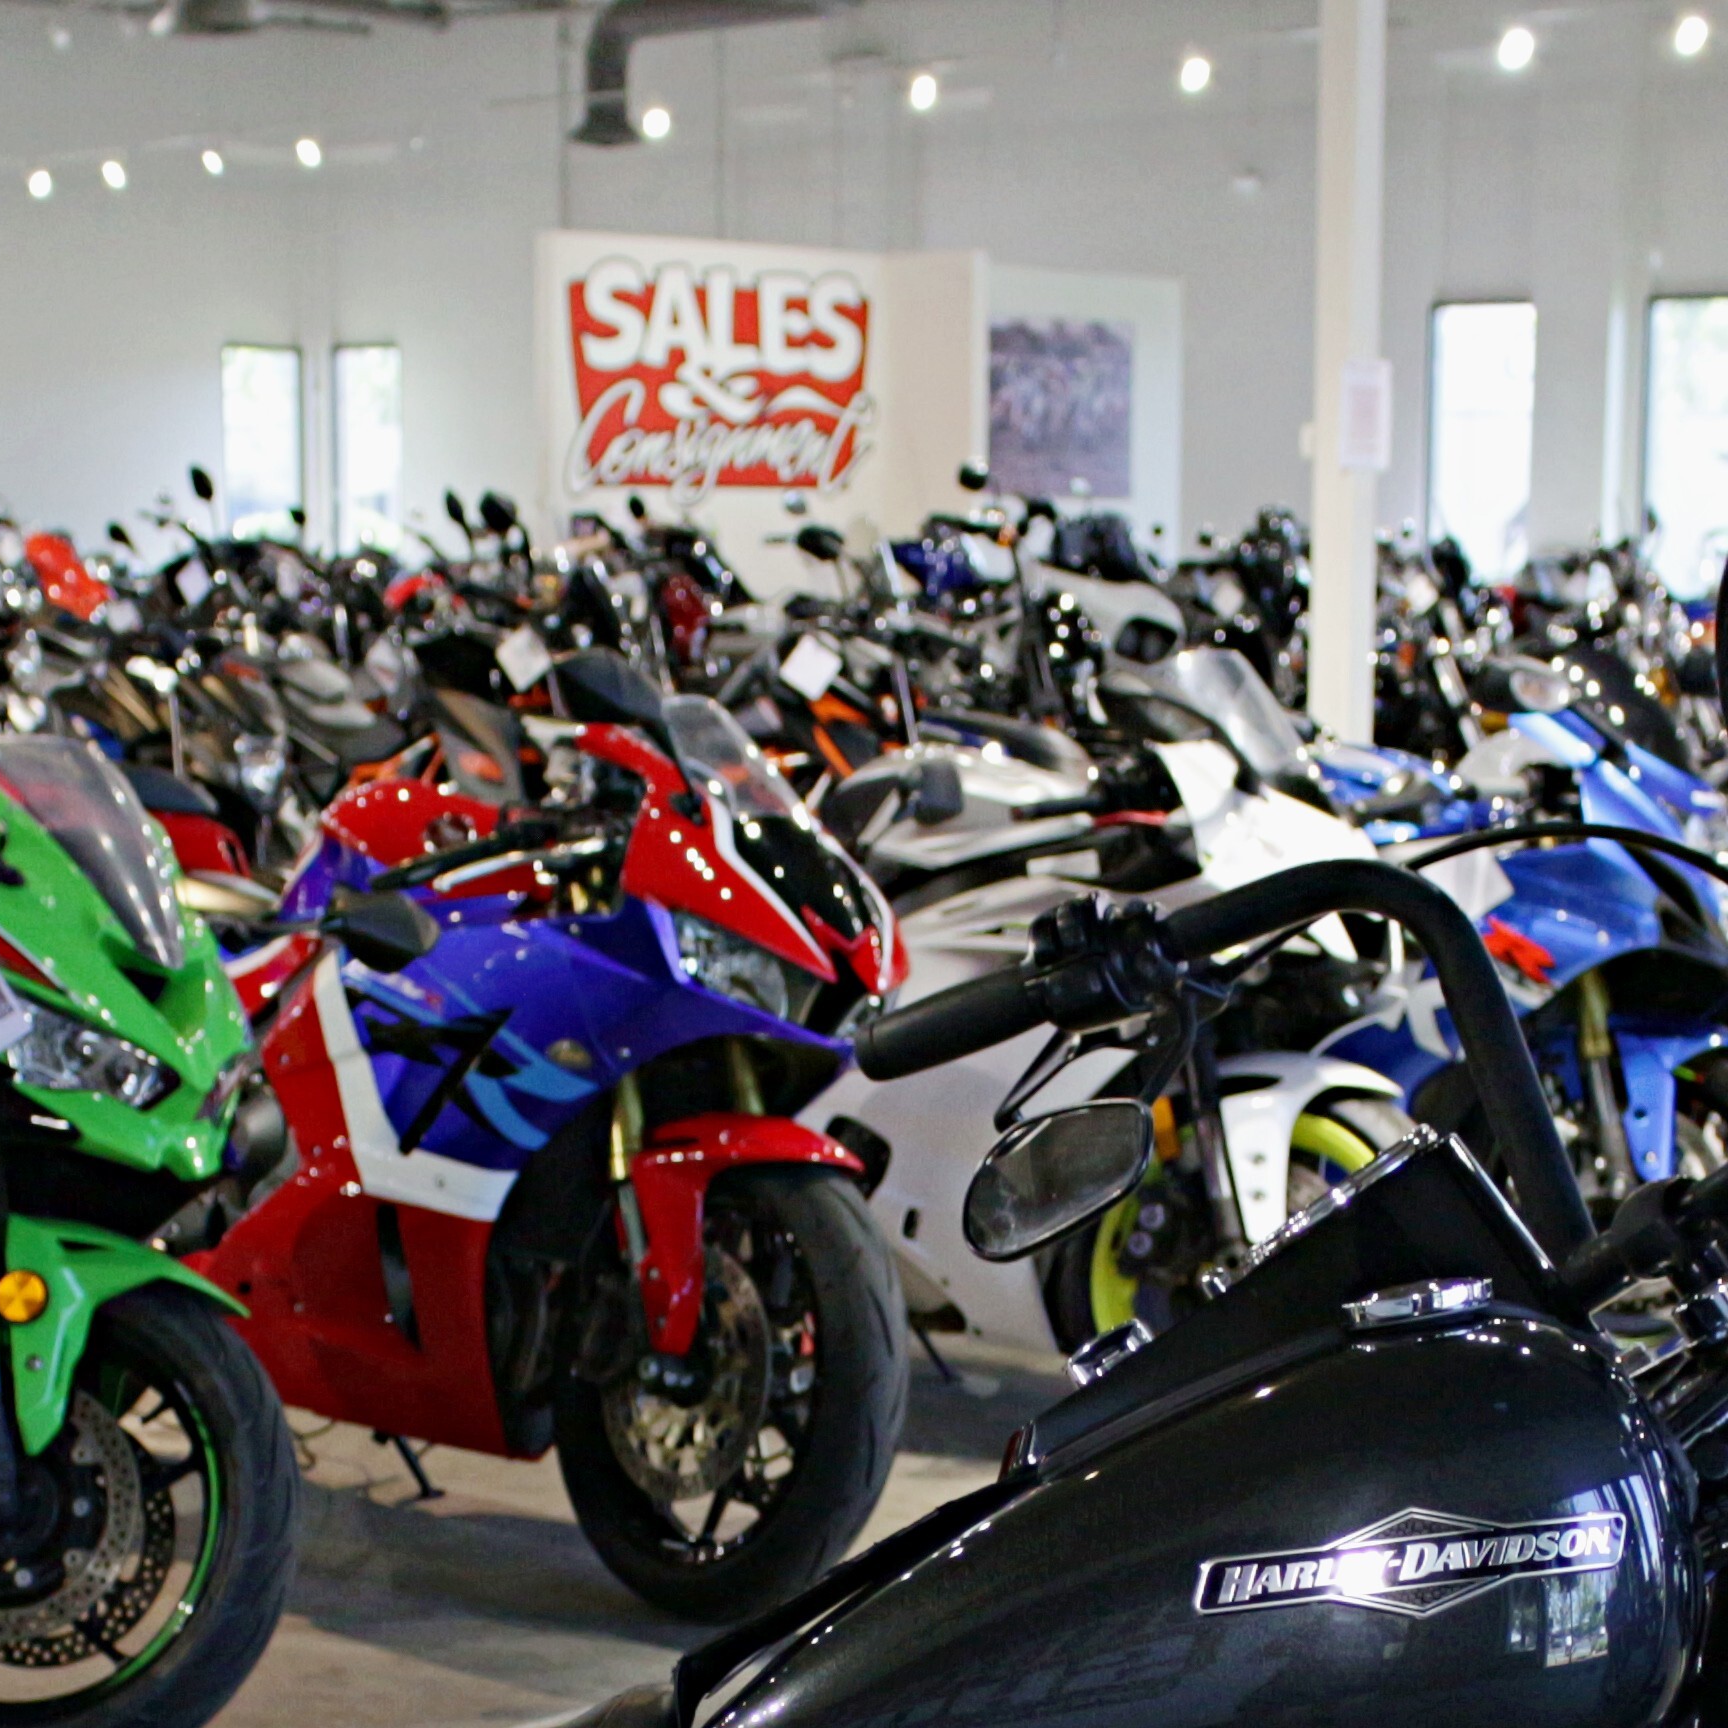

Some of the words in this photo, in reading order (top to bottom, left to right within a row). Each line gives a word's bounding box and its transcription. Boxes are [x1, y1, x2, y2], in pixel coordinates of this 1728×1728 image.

[578, 254, 868, 383] SALES
[658, 360, 766, 424] &
[1217, 1525, 1612, 1605] HARL-DAVIDSON
